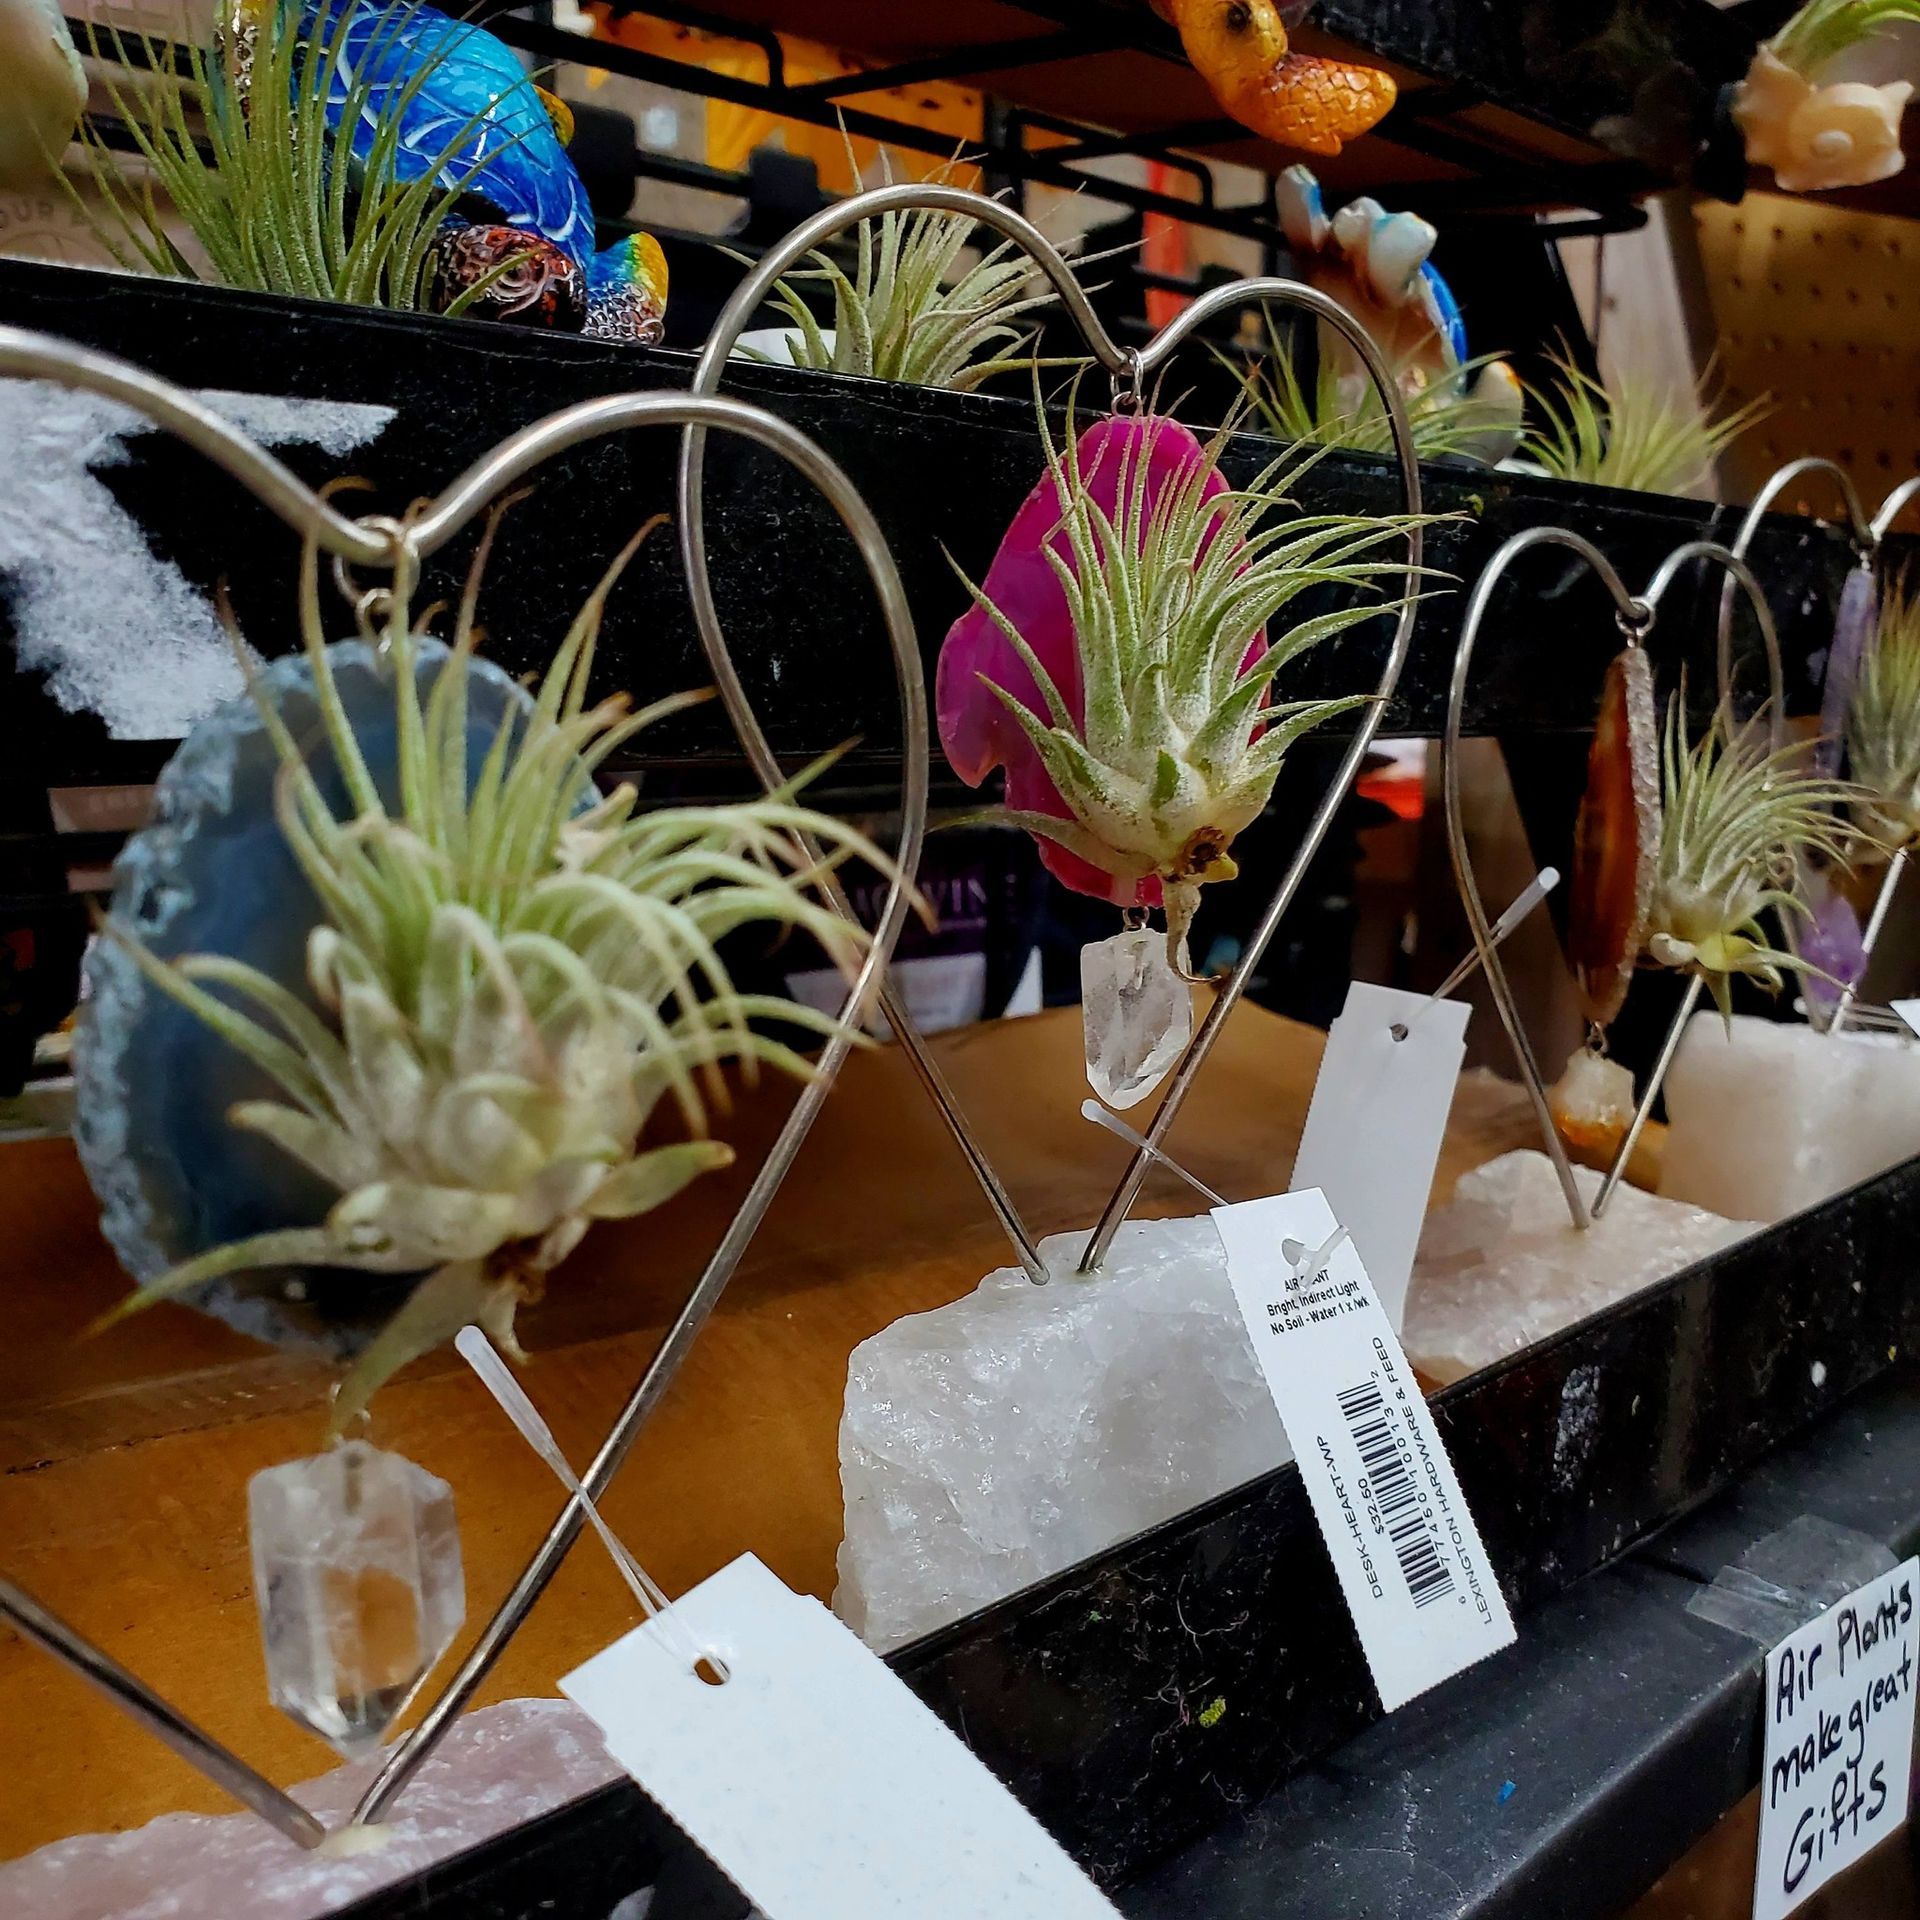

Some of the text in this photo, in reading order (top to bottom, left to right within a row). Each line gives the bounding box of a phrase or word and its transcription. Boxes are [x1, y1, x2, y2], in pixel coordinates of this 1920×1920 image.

[1266, 1280, 1360, 1316] Bright, Indirect Light
[1270, 1322, 1285, 1336] No
[1285, 1315, 1304, 1331] Soil
[1309, 1306, 1338, 1323] Water
[1338, 1302, 1345, 1314] 1
[1284, 1278, 1300, 1292] AIR
[1316, 1434, 1384, 1600] DESK-HEART-WP
[1357, 1477, 1385, 1536] $32.50
[1369, 1369, 1467, 1605] 6 77450 10013 2
[1372, 1336, 1493, 1626] LEXINGTON HARDWARE & FEED
[1776, 1579, 1914, 1724] Air Plants
[1770, 1708, 1844, 1809] make
[1783, 1759, 1889, 1895] Gifts
